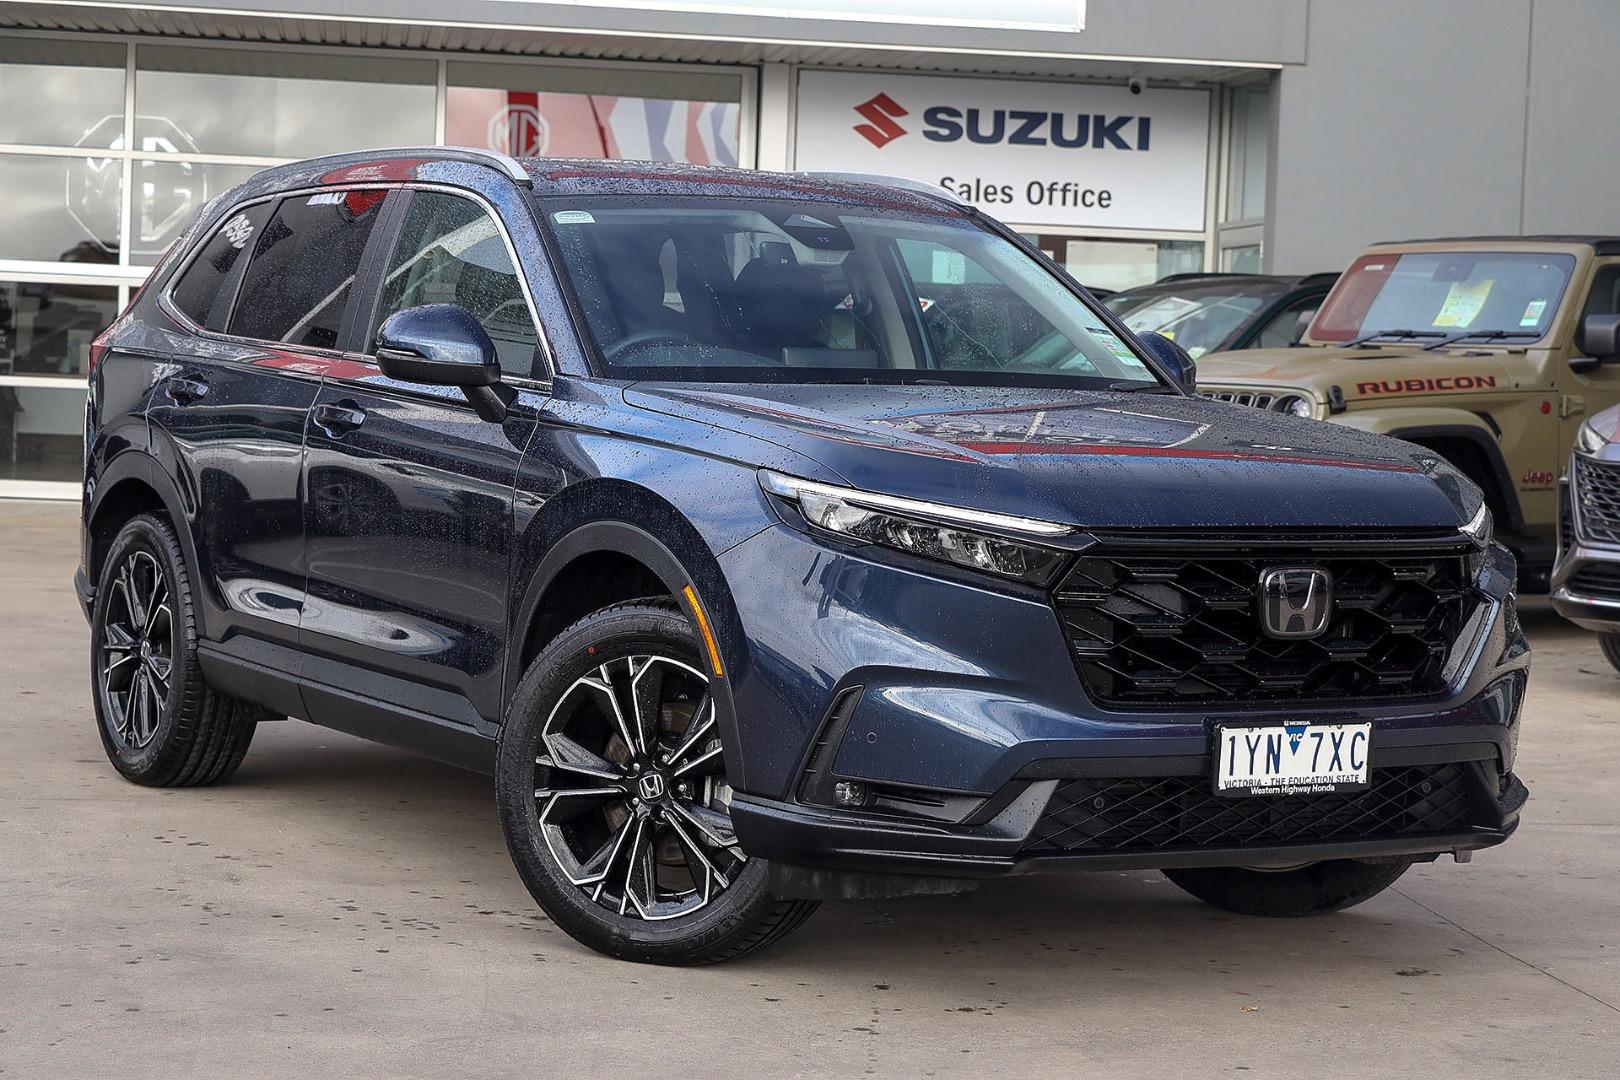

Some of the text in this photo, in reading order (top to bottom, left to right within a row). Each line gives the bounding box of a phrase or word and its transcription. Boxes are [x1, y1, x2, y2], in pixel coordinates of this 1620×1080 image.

[922, 105, 1151, 151] SUZUKI
[1026, 180, 1112, 208] Office
[1356, 376, 1496, 395] RUBICON
[1289, 733, 1303, 742] VIC
[1229, 731, 1366, 776] 1YN 7XC
[1224, 778, 1262, 788] VICTORIA
[1270, 777, 1285, 785] THE
[1288, 775, 1333, 785] EDUCATION
[1336, 774, 1360, 783] STATE
[1250, 784, 1335, 795] Western Highway Honda
